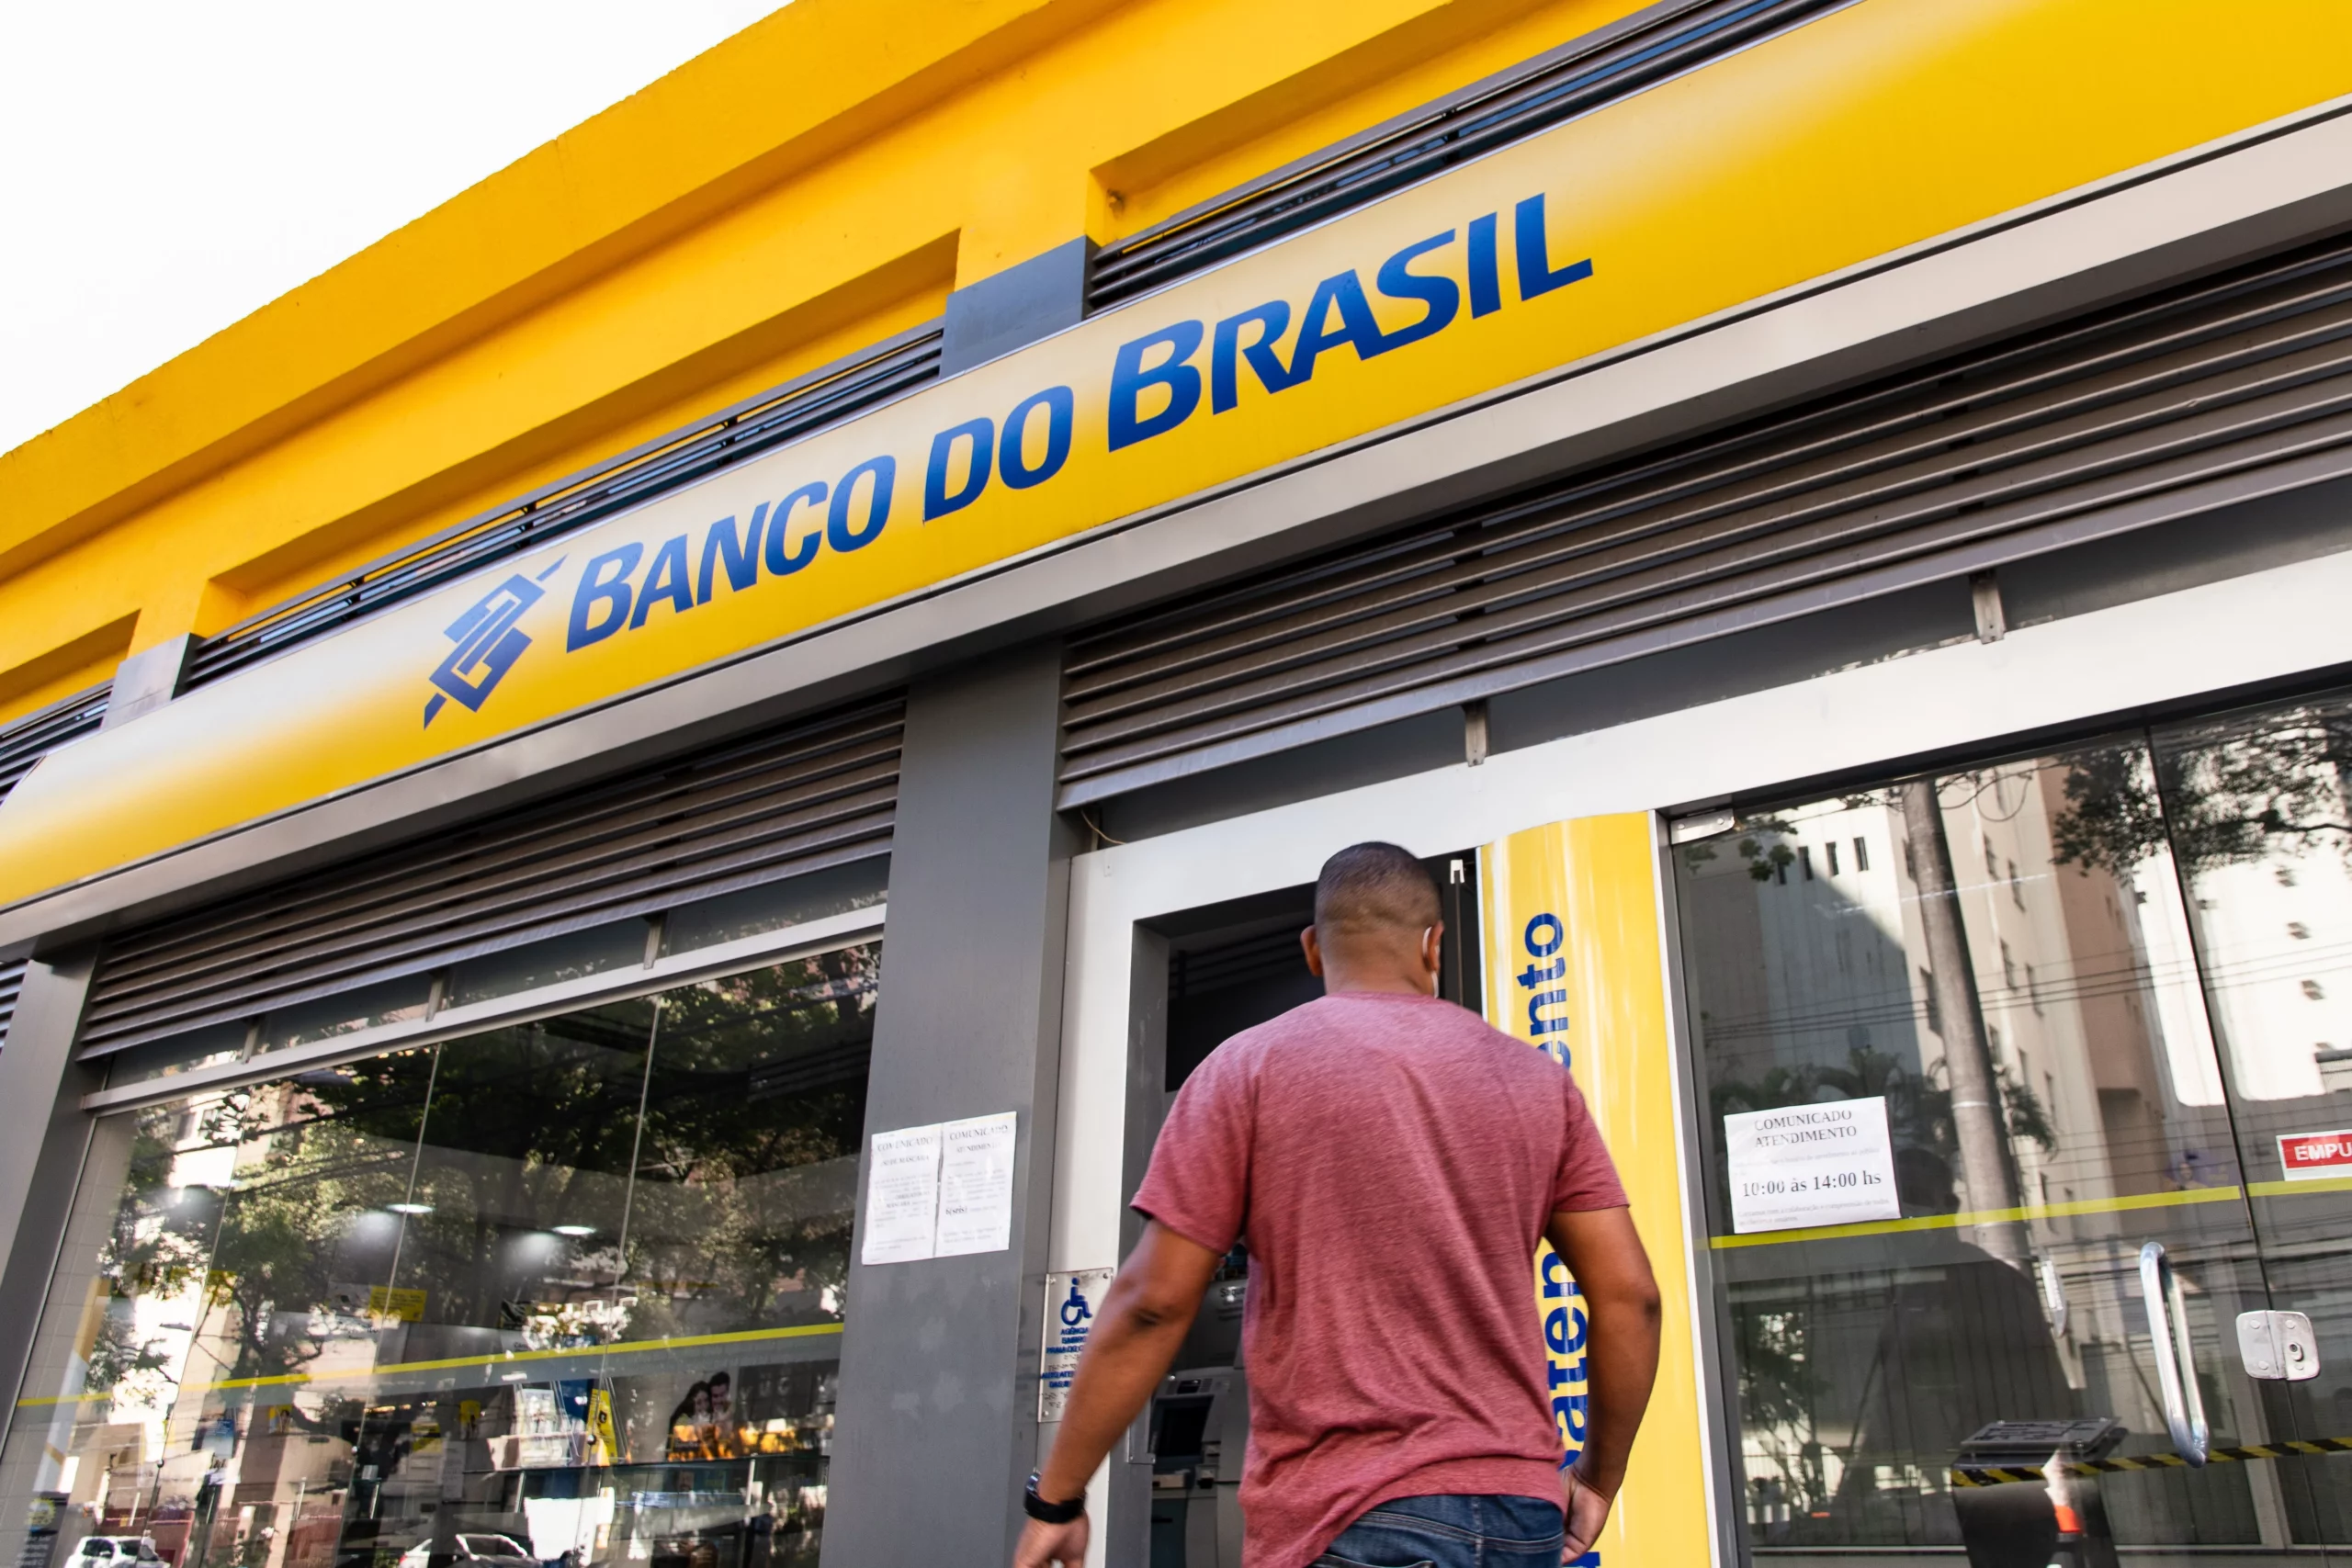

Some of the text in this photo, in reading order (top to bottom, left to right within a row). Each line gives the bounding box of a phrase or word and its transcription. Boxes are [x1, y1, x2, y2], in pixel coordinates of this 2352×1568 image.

[568, 193, 1593, 653] BANCO DO BRASIL
[949, 1124, 1008, 1141] COMUNICADO
[1755, 1111, 1852, 1131] COMUNICADO
[1755, 1125, 1857, 1148] ATENDIMENTO
[1743, 1170, 1882, 1197] 10:00 às 14:00 hs
